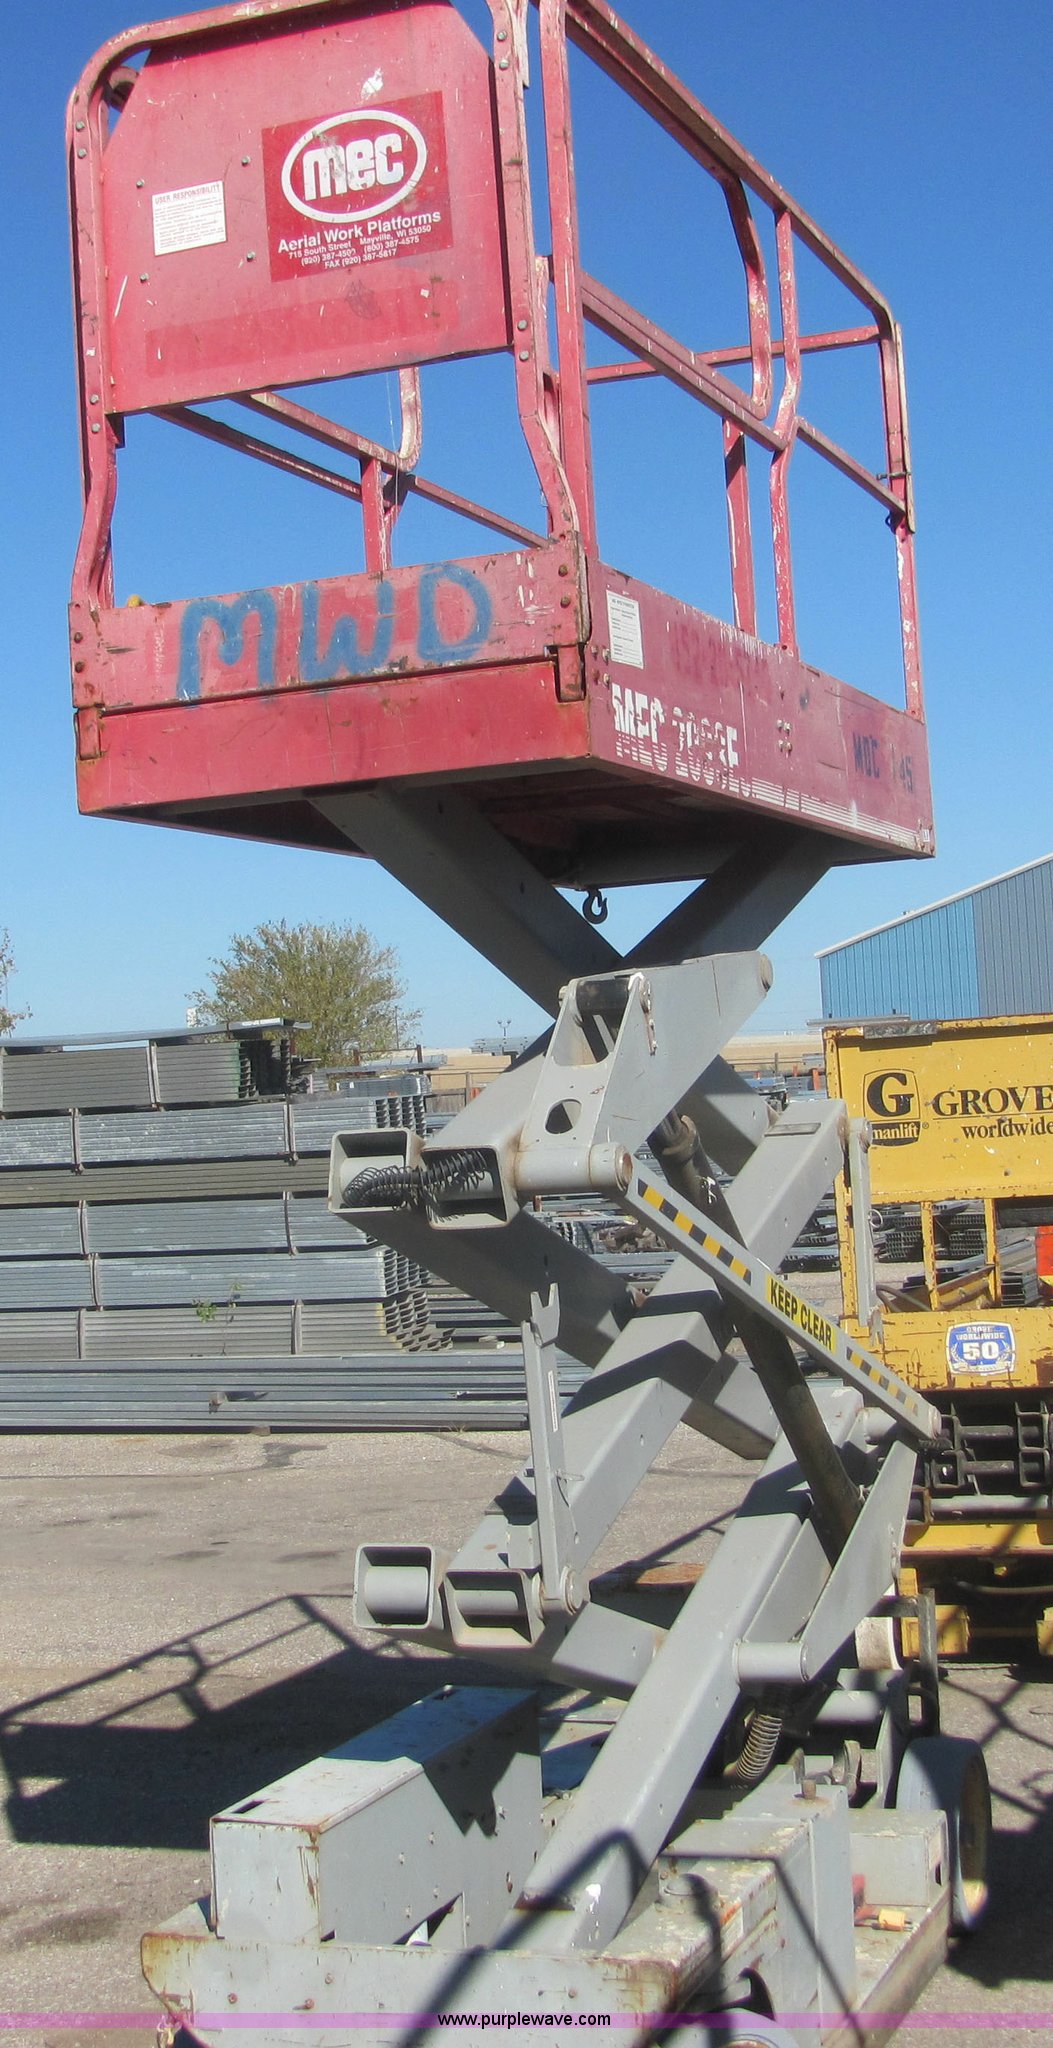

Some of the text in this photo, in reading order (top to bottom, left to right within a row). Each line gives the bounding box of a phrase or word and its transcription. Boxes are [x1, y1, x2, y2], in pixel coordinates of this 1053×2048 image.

[154, 184, 220, 205] USER RESPONSIBILITY
[278, 211, 441, 253] Aerial Work Platforms
[289, 250, 303, 260] 715
[304, 245, 327, 257] South
[328, 240, 351, 251] Street
[360, 233, 394, 246] Mayville,
[408, 224, 432, 236] 53050
[324, 259, 341, 269] FAX
[176, 563, 493, 701] MWD
[867, 1072, 914, 1117] G
[932, 1084, 1053, 1117] GROVE
[872, 1122, 919, 1140] manlift
[961, 1115, 1053, 1140] worldwide
[770, 1278, 832, 1351] KEEP CLEAR
[962, 1341, 999, 1360] 50
